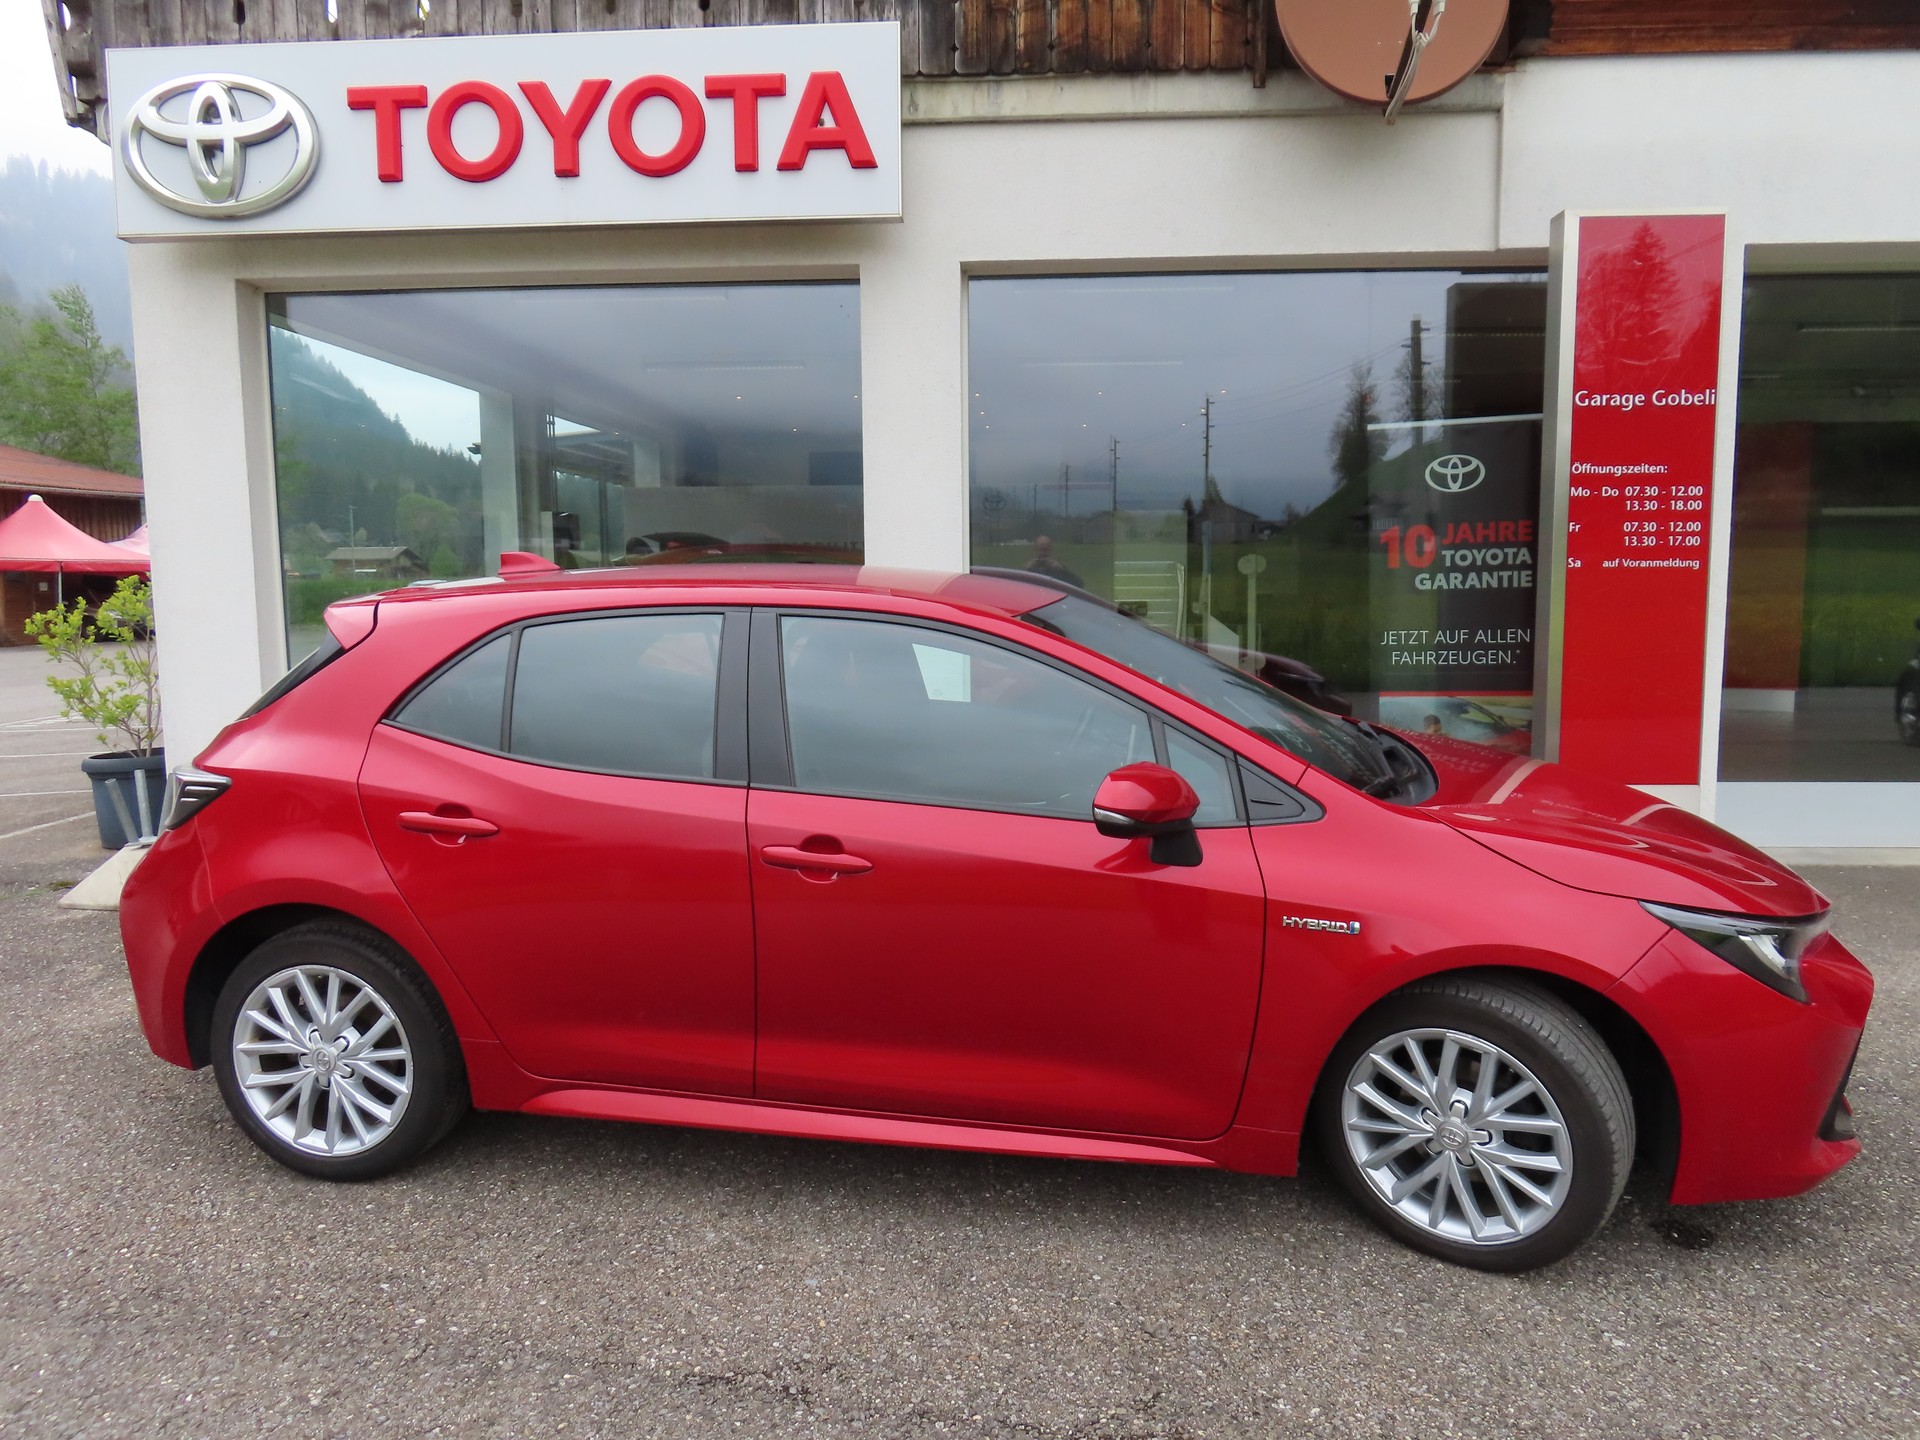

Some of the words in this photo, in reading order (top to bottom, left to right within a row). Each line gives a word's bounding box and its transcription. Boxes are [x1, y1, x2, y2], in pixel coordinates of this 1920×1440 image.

[347, 71, 879, 183] TOYOTA
[1575, 390, 1645, 411] Garage
[1652, 389, 1716, 406] Gobeli
[1572, 462, 1668, 476] Öffnungszeiten:
[1570, 486, 1591, 497] Mo
[1602, 486, 1619, 497] Do
[1625, 486, 1659, 496] 07.30
[1671, 485, 1703, 496] 12.00
[1625, 500, 1658, 511] 13.30
[1670, 500, 1703, 511] 18.00
[1569, 522, 1581, 532] Fr
[1623, 522, 1657, 532] 07.30
[1669, 521, 1702, 532] 12.00
[1380, 523, 1437, 569] 10
[1441, 520, 1534, 545] JAHRE
[1623, 536, 1656, 547] 13.30
[1668, 536, 1701, 546] 17.00
[1441, 547, 1533, 567] TOYOTA
[1568, 557, 1581, 568] Sa
[1602, 558, 1619, 568] auf
[1622, 558, 1700, 570] Voranmeldung
[1414, 570, 1533, 590] GARANTIE
[1381, 630, 1429, 645] JETZT
[1434, 629, 1469, 644] AUF
[1474, 628, 1531, 643] ALLEN
[1282, 915, 1348, 933] HYBRID
